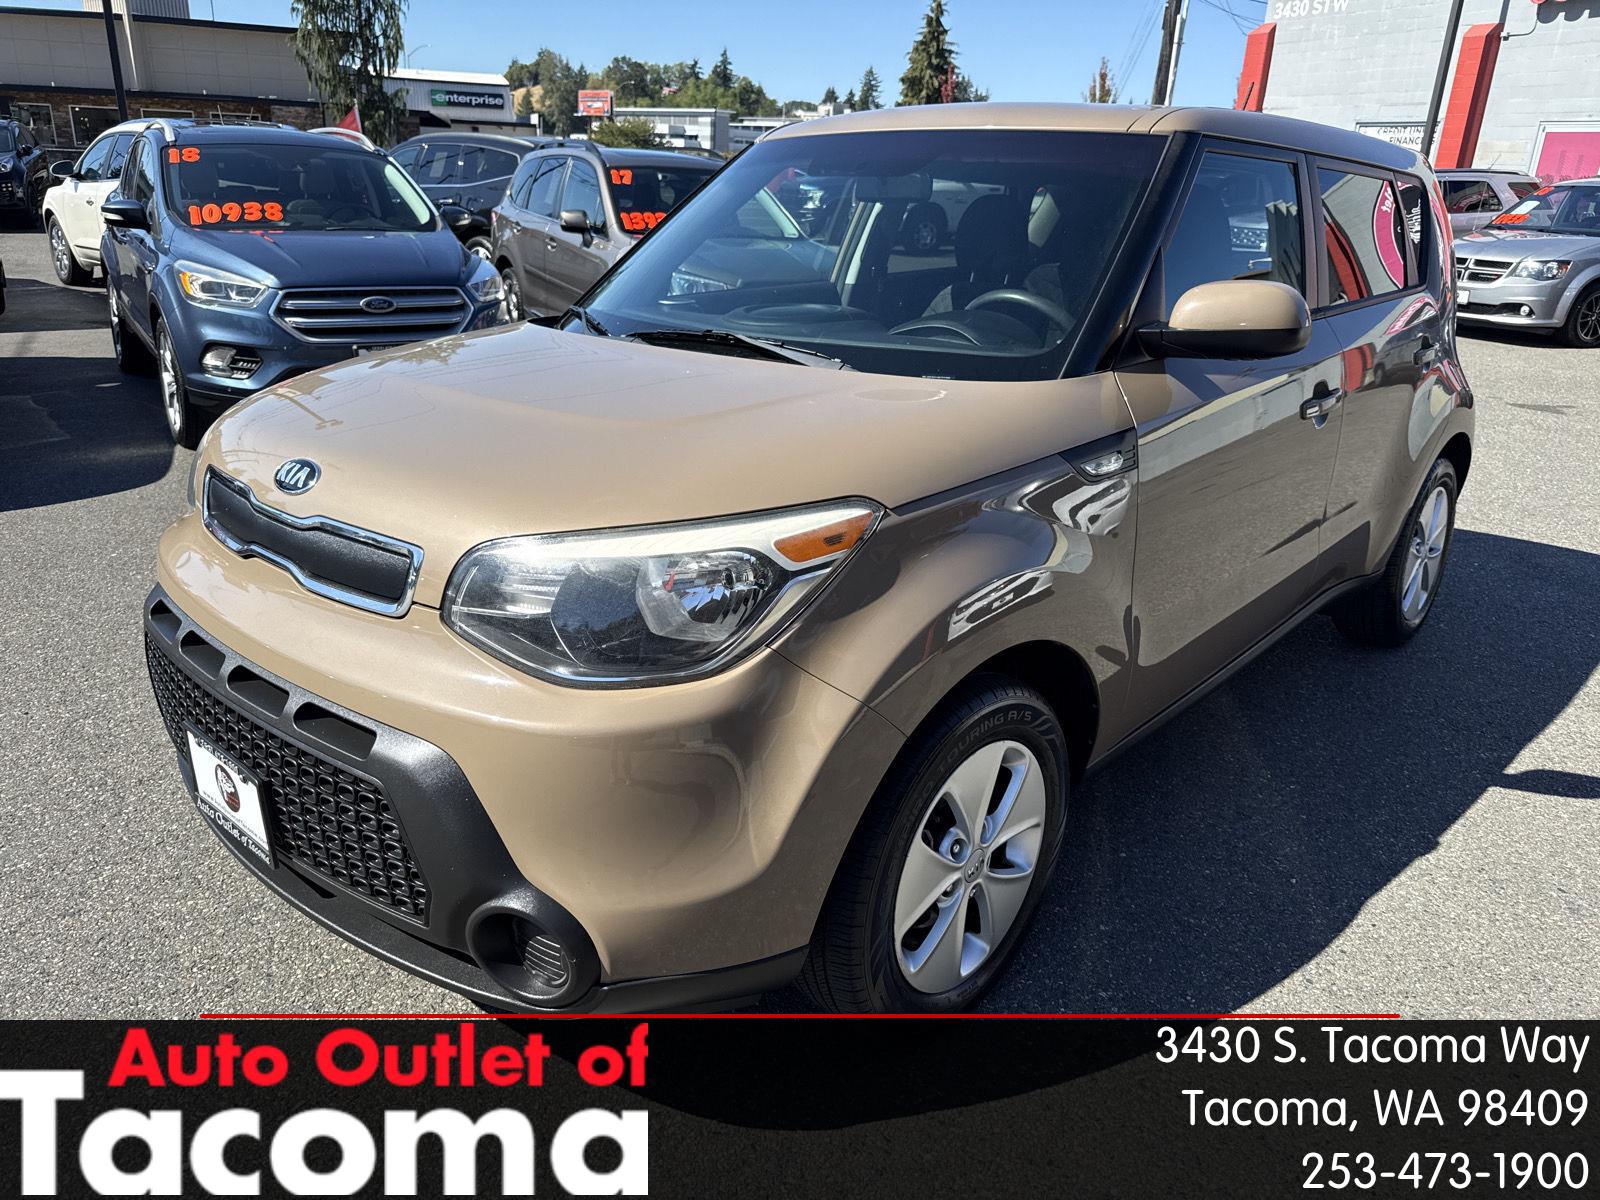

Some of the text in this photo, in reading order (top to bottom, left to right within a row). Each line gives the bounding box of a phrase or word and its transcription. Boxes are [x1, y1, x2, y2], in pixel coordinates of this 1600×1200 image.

[1273, 0, 1310, 19] 3430
[432, 93, 504, 106] enterprise
[168, 147, 200, 164] 18
[610, 169, 633, 185] 17
[188, 201, 284, 226] 10938
[276, 461, 311, 488] KIA
[938, 710, 1032, 775] TOURING A/S
